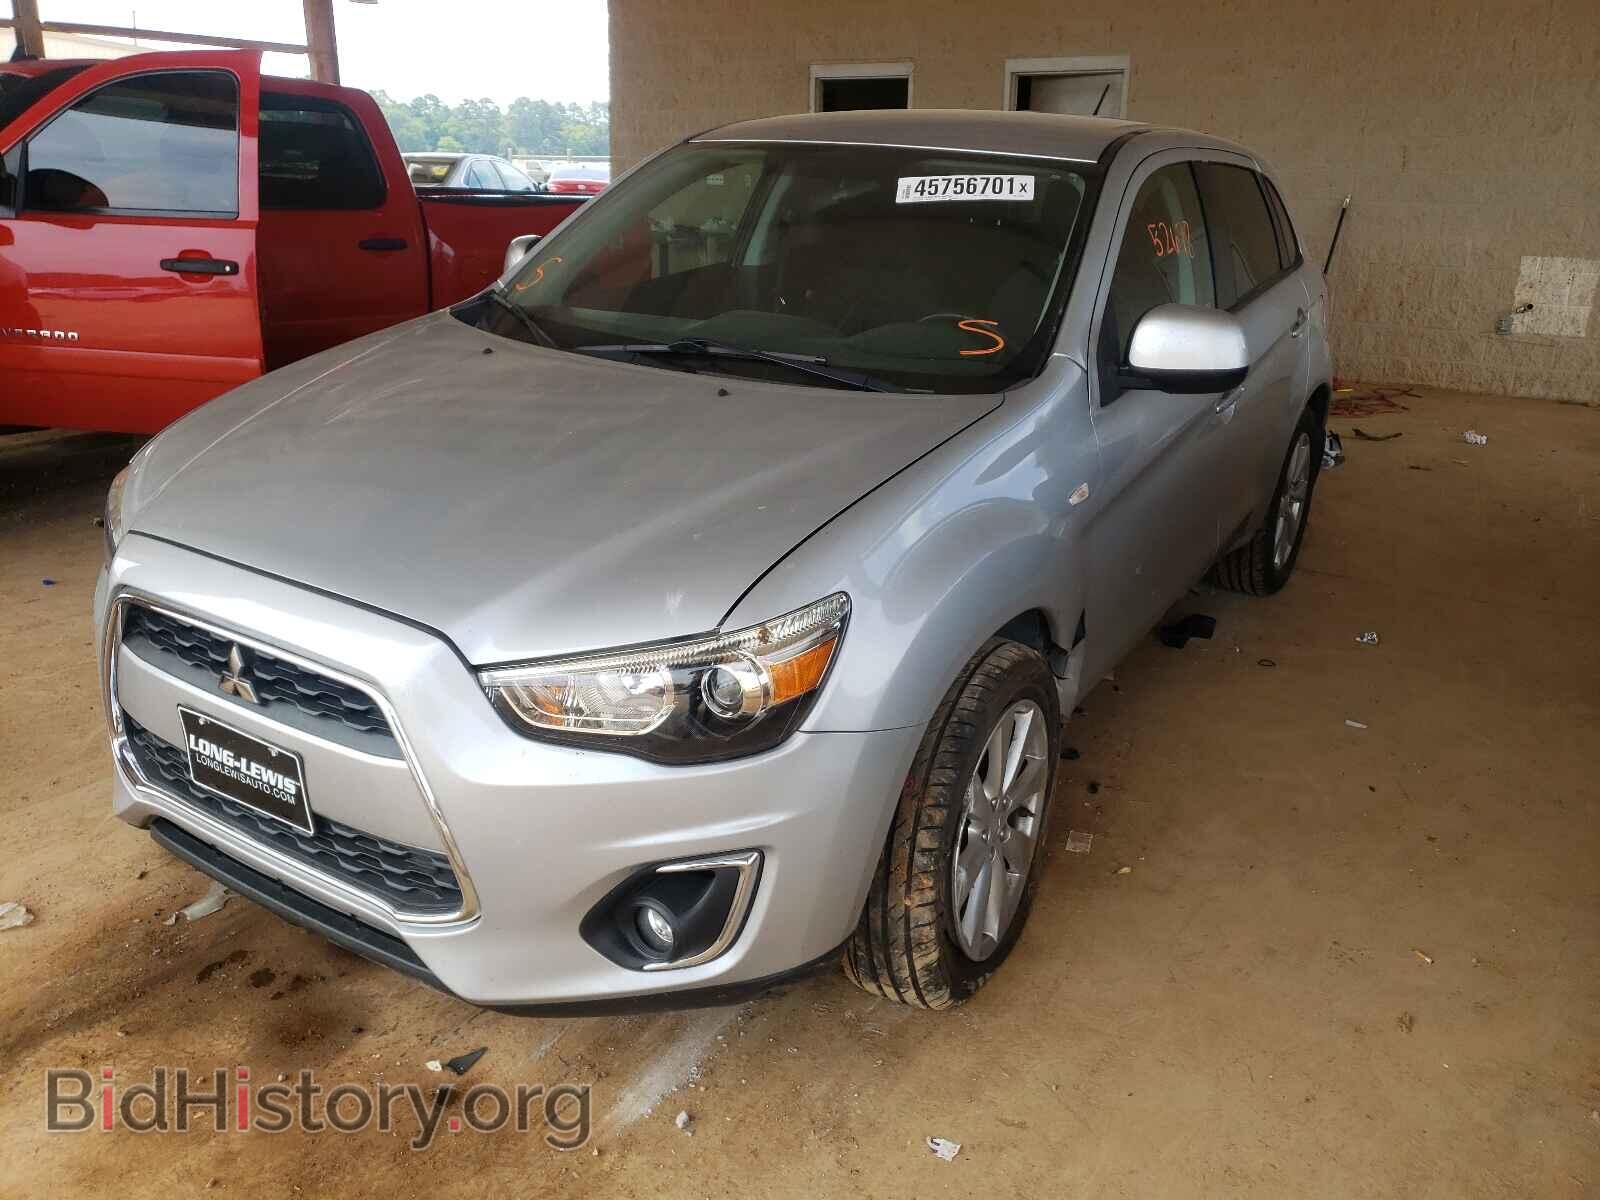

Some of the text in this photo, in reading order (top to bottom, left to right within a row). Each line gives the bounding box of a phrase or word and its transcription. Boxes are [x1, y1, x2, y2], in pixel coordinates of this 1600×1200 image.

[914, 177, 1015, 196] 45756701
[958, 319, 1004, 356] S
[189, 733, 297, 796] LONG-LEWIS
[196, 752, 296, 806] LONGLEWISAUTO.COM
